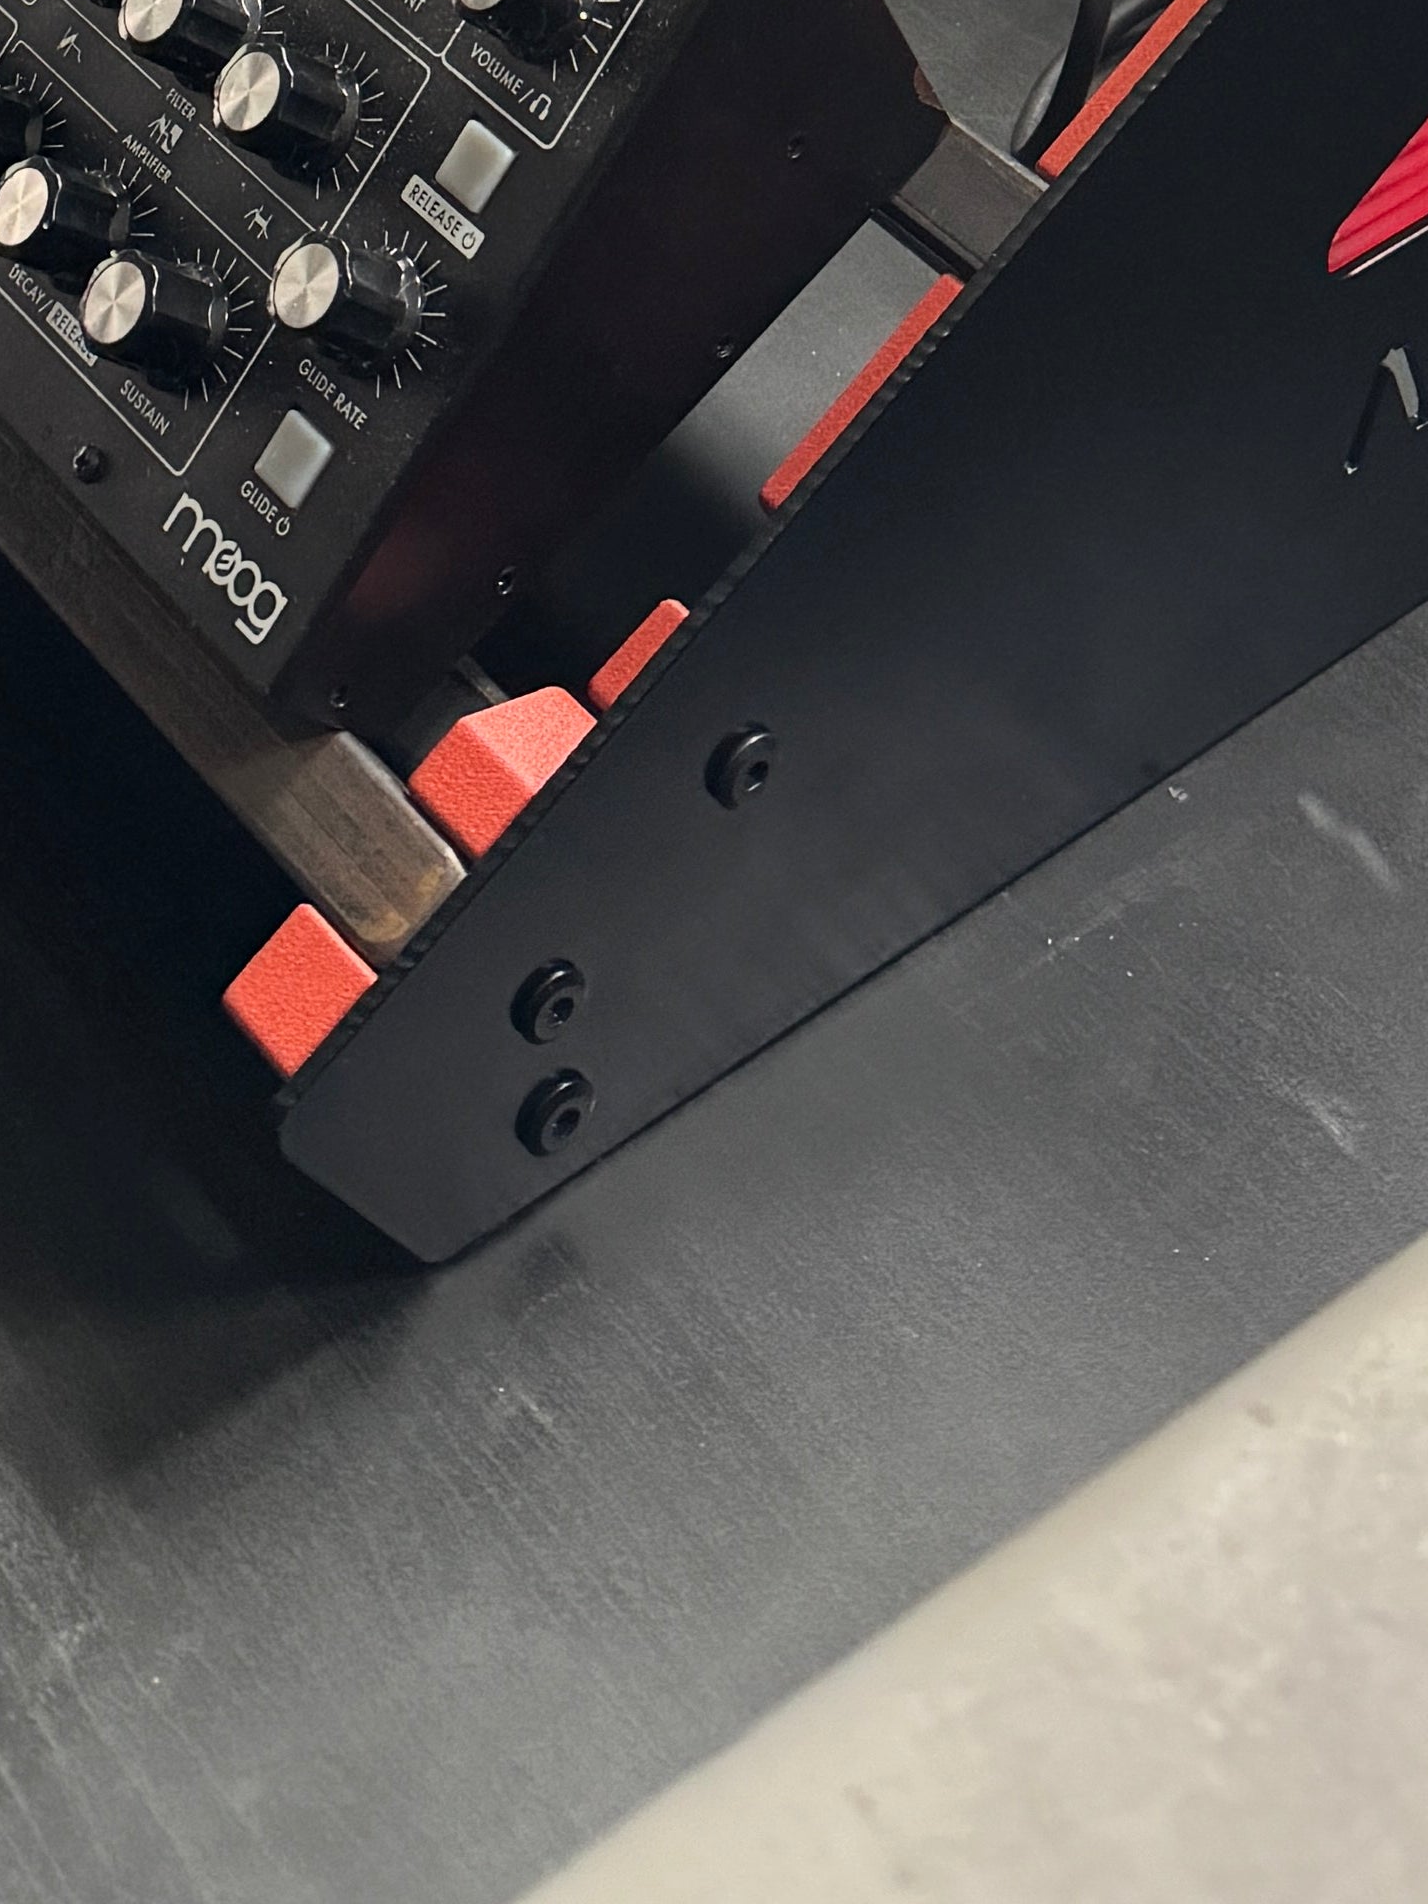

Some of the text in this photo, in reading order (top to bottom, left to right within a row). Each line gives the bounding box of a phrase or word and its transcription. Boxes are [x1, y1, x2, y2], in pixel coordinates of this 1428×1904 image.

[471, 42, 524, 95] VOLUME
[165, 88, 197, 122] FILTER
[122, 134, 173, 184] AMPLIFIER
[408, 184, 463, 239] RELEASE
[8, 264, 46, 305] DECAY
[120, 379, 170, 436] SUSTAIN
[299, 359, 368, 431] GLIDE RATE
[240, 480, 280, 524] GLIDE
[162, 492, 288, 645] moog
